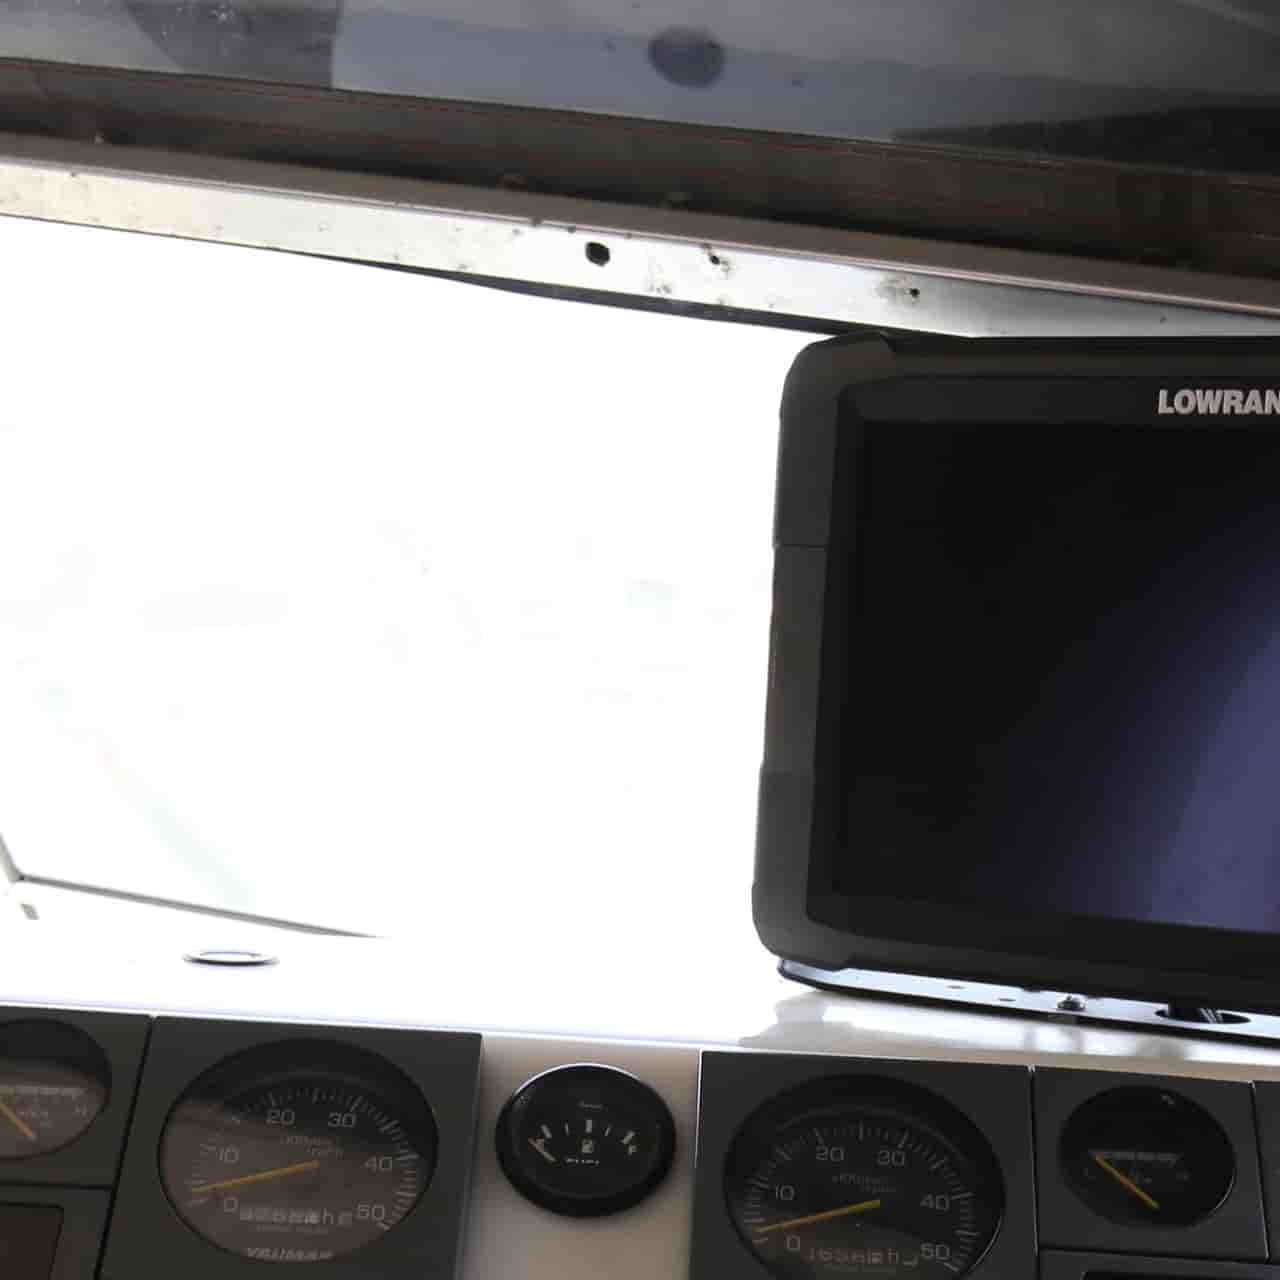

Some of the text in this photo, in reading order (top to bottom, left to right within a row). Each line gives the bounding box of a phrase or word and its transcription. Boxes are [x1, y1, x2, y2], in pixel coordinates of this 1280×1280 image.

[266, 1109, 296, 1127] 20
[327, 1111, 358, 1128] 30
[217, 1144, 241, 1166] 10
[815, 1145, 845, 1162] 20
[877, 1150, 906, 1168] 30
[362, 1155, 394, 1173] 40
[774, 1184, 796, 1202] 10
[920, 1193, 951, 1211] 40
[223, 1195, 240, 1215] 0
[784, 1231, 801, 1252] 0
